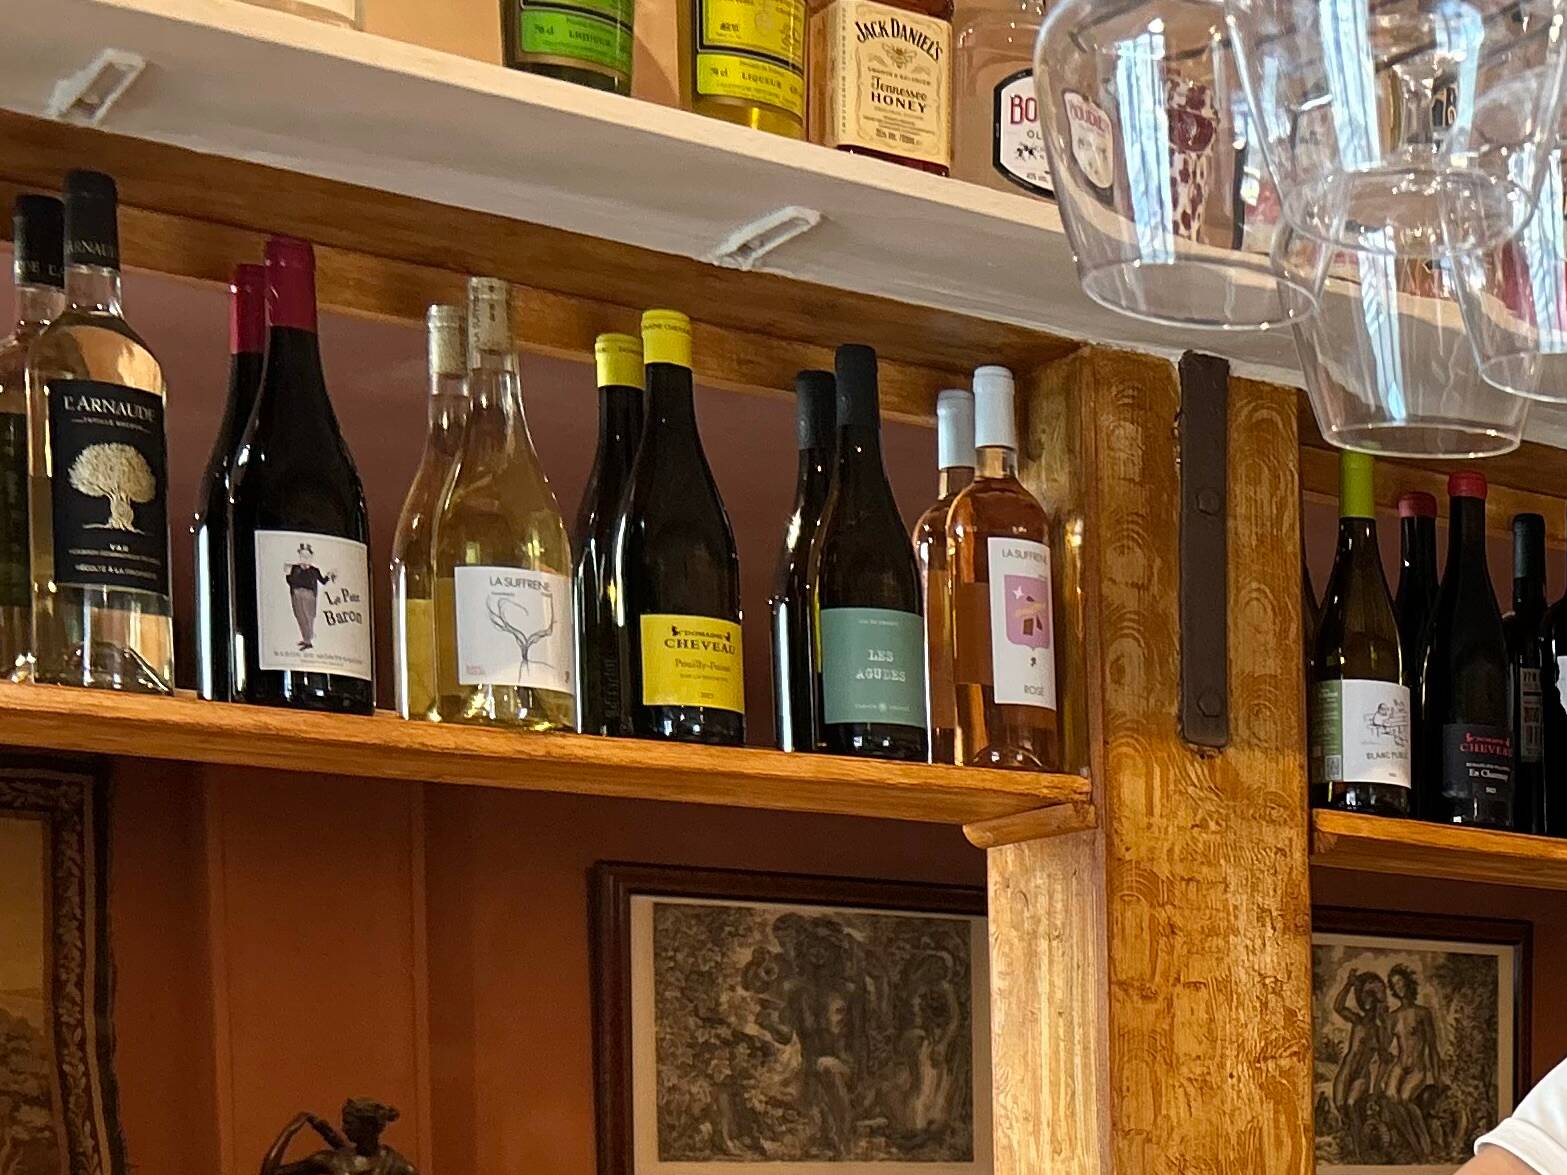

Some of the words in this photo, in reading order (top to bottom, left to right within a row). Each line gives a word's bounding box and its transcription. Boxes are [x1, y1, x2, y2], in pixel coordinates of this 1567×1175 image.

[855, 20, 889, 43] JACK
[890, 17, 943, 64] DANIEL'S
[871, 75, 928, 101] Tennessee
[871, 91, 927, 114] HONEY
[1010, 93, 1038, 125] BO
[63, 395, 155, 422] L'ARNAUDE
[489, 575, 503, 587] LA
[323, 610, 363, 627] Baron
[664, 638, 736, 655] CHEVEAU
[867, 649, 894, 663] LES
[855, 667, 906, 682] AGUDES
